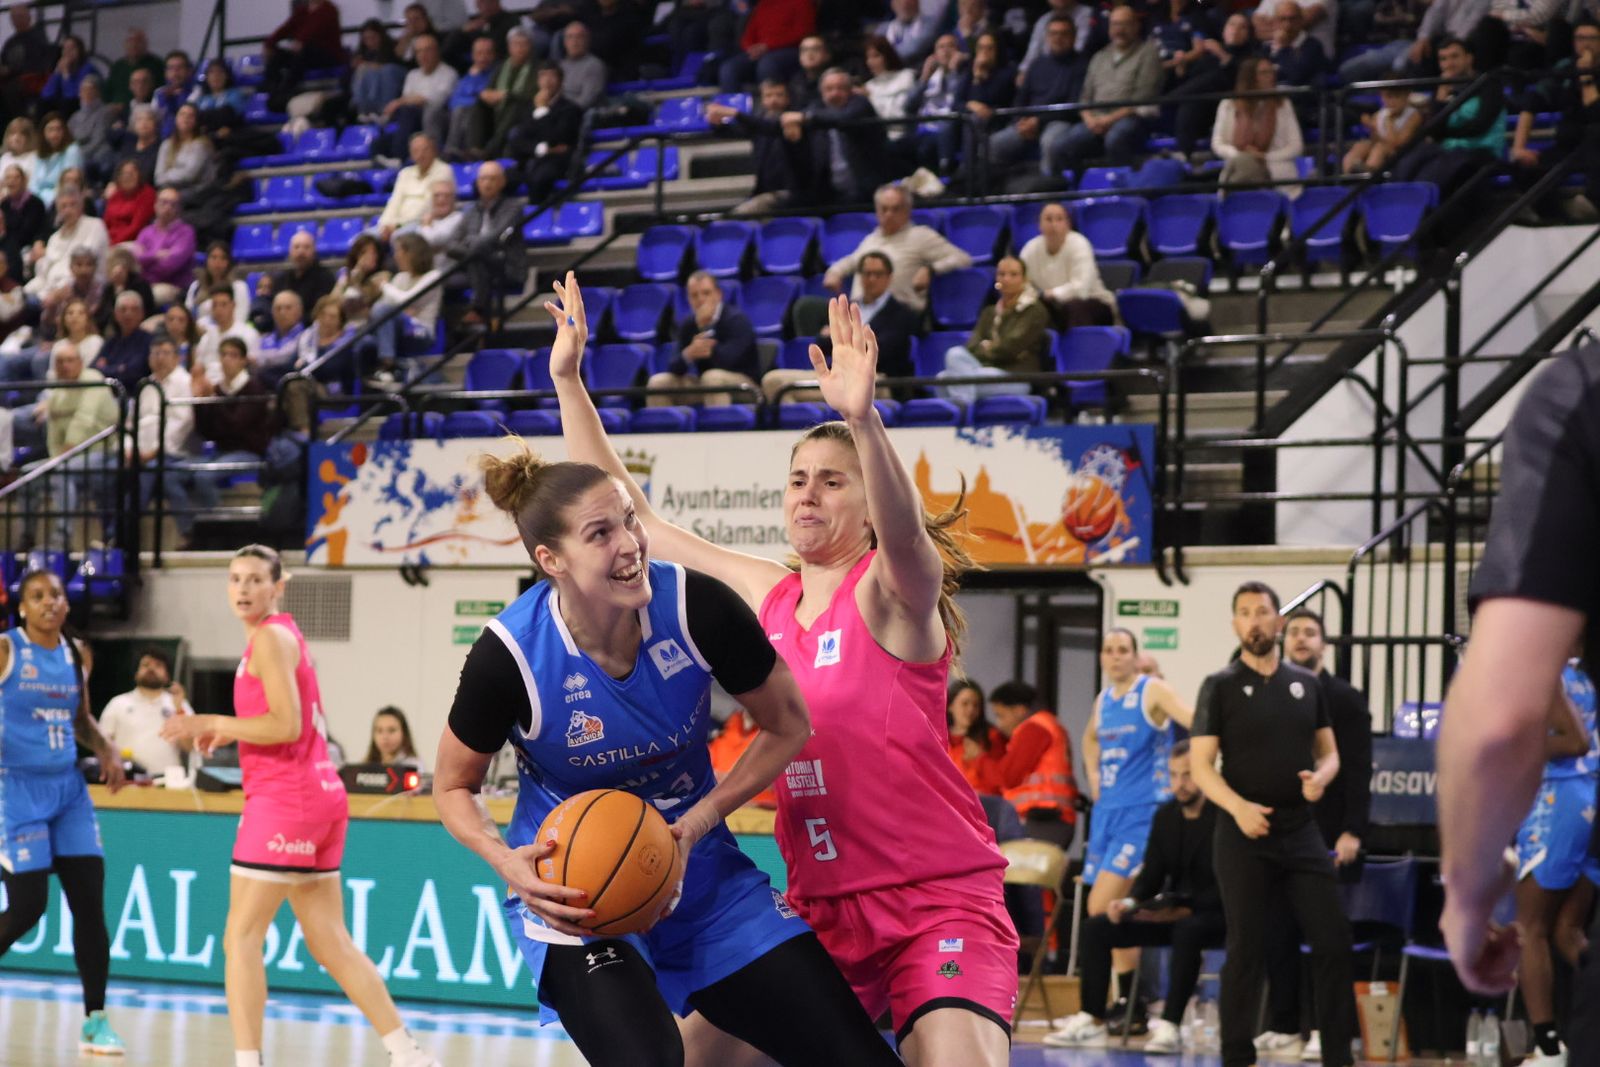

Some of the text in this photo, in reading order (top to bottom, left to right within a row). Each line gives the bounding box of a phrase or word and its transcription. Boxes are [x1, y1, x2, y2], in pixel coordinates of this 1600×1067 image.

[662, 482, 783, 516] Ayuntamien
[568, 741, 661, 767] CASTILLA
[667, 732, 680, 748] Y
[569, 731, 602, 747] AVENIDA
[284, 840, 316, 855] eitb
[805, 817, 839, 861] 5
